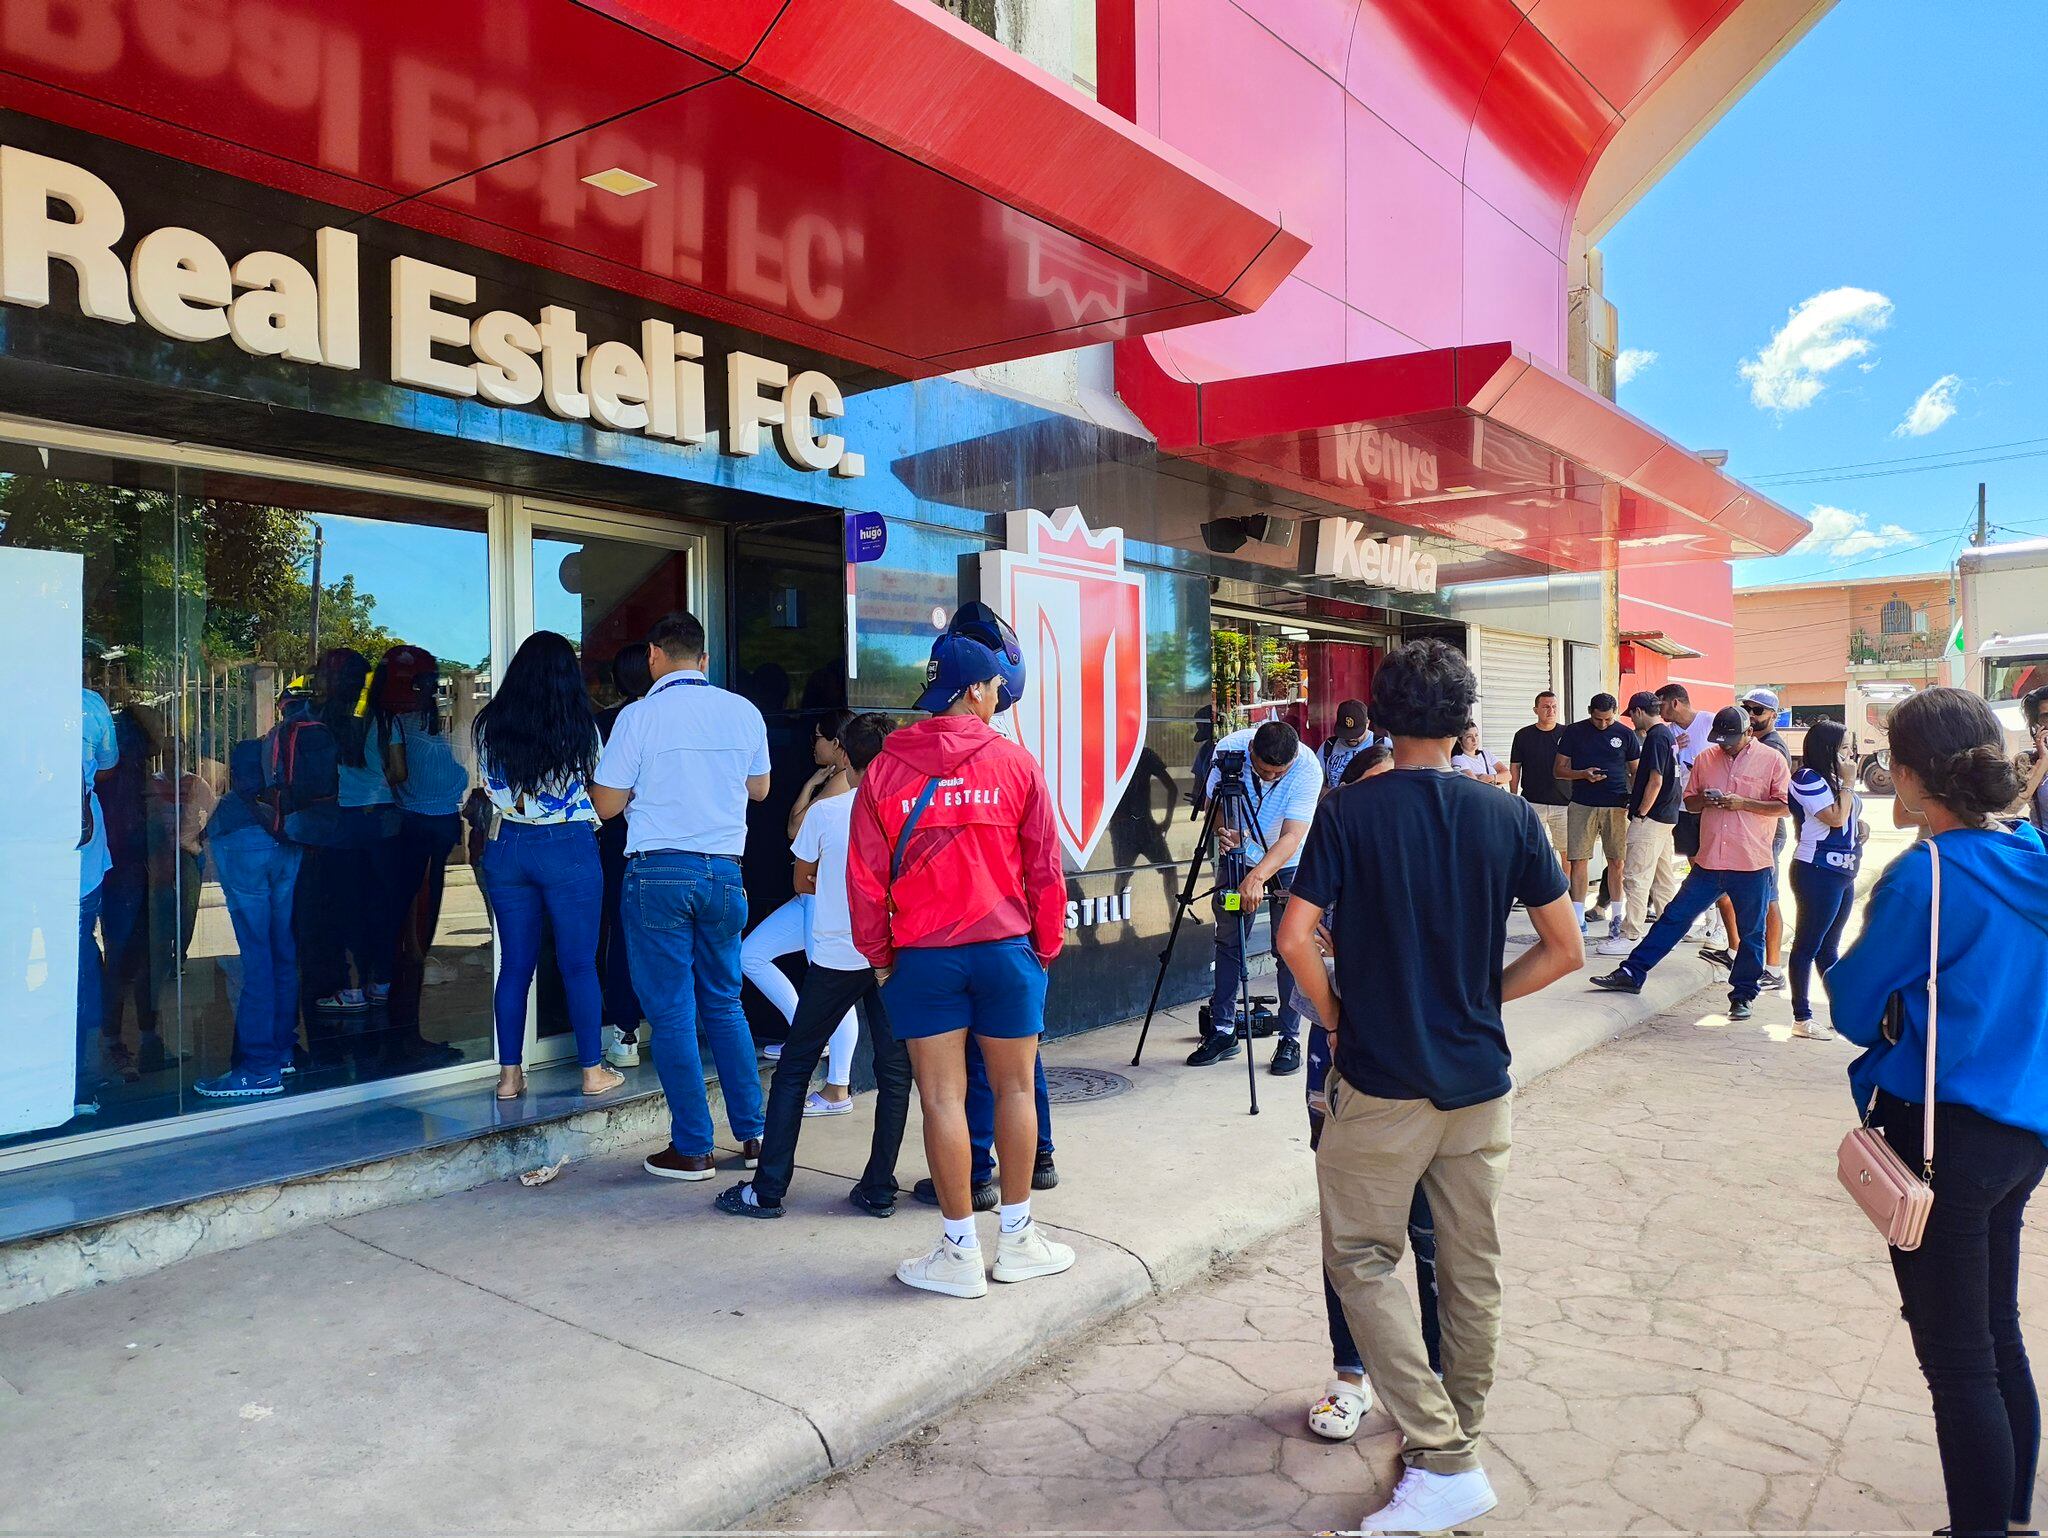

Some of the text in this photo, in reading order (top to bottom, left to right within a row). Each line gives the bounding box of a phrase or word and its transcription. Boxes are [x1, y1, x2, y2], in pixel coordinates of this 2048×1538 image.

[0, 144, 865, 478] Real Esteli FC.
[860, 528, 882, 540] hugo
[1316, 516, 1438, 594] Keuka
[944, 787, 1000, 806] ESTELÍ
[1064, 886, 1132, 929] STELÍ
